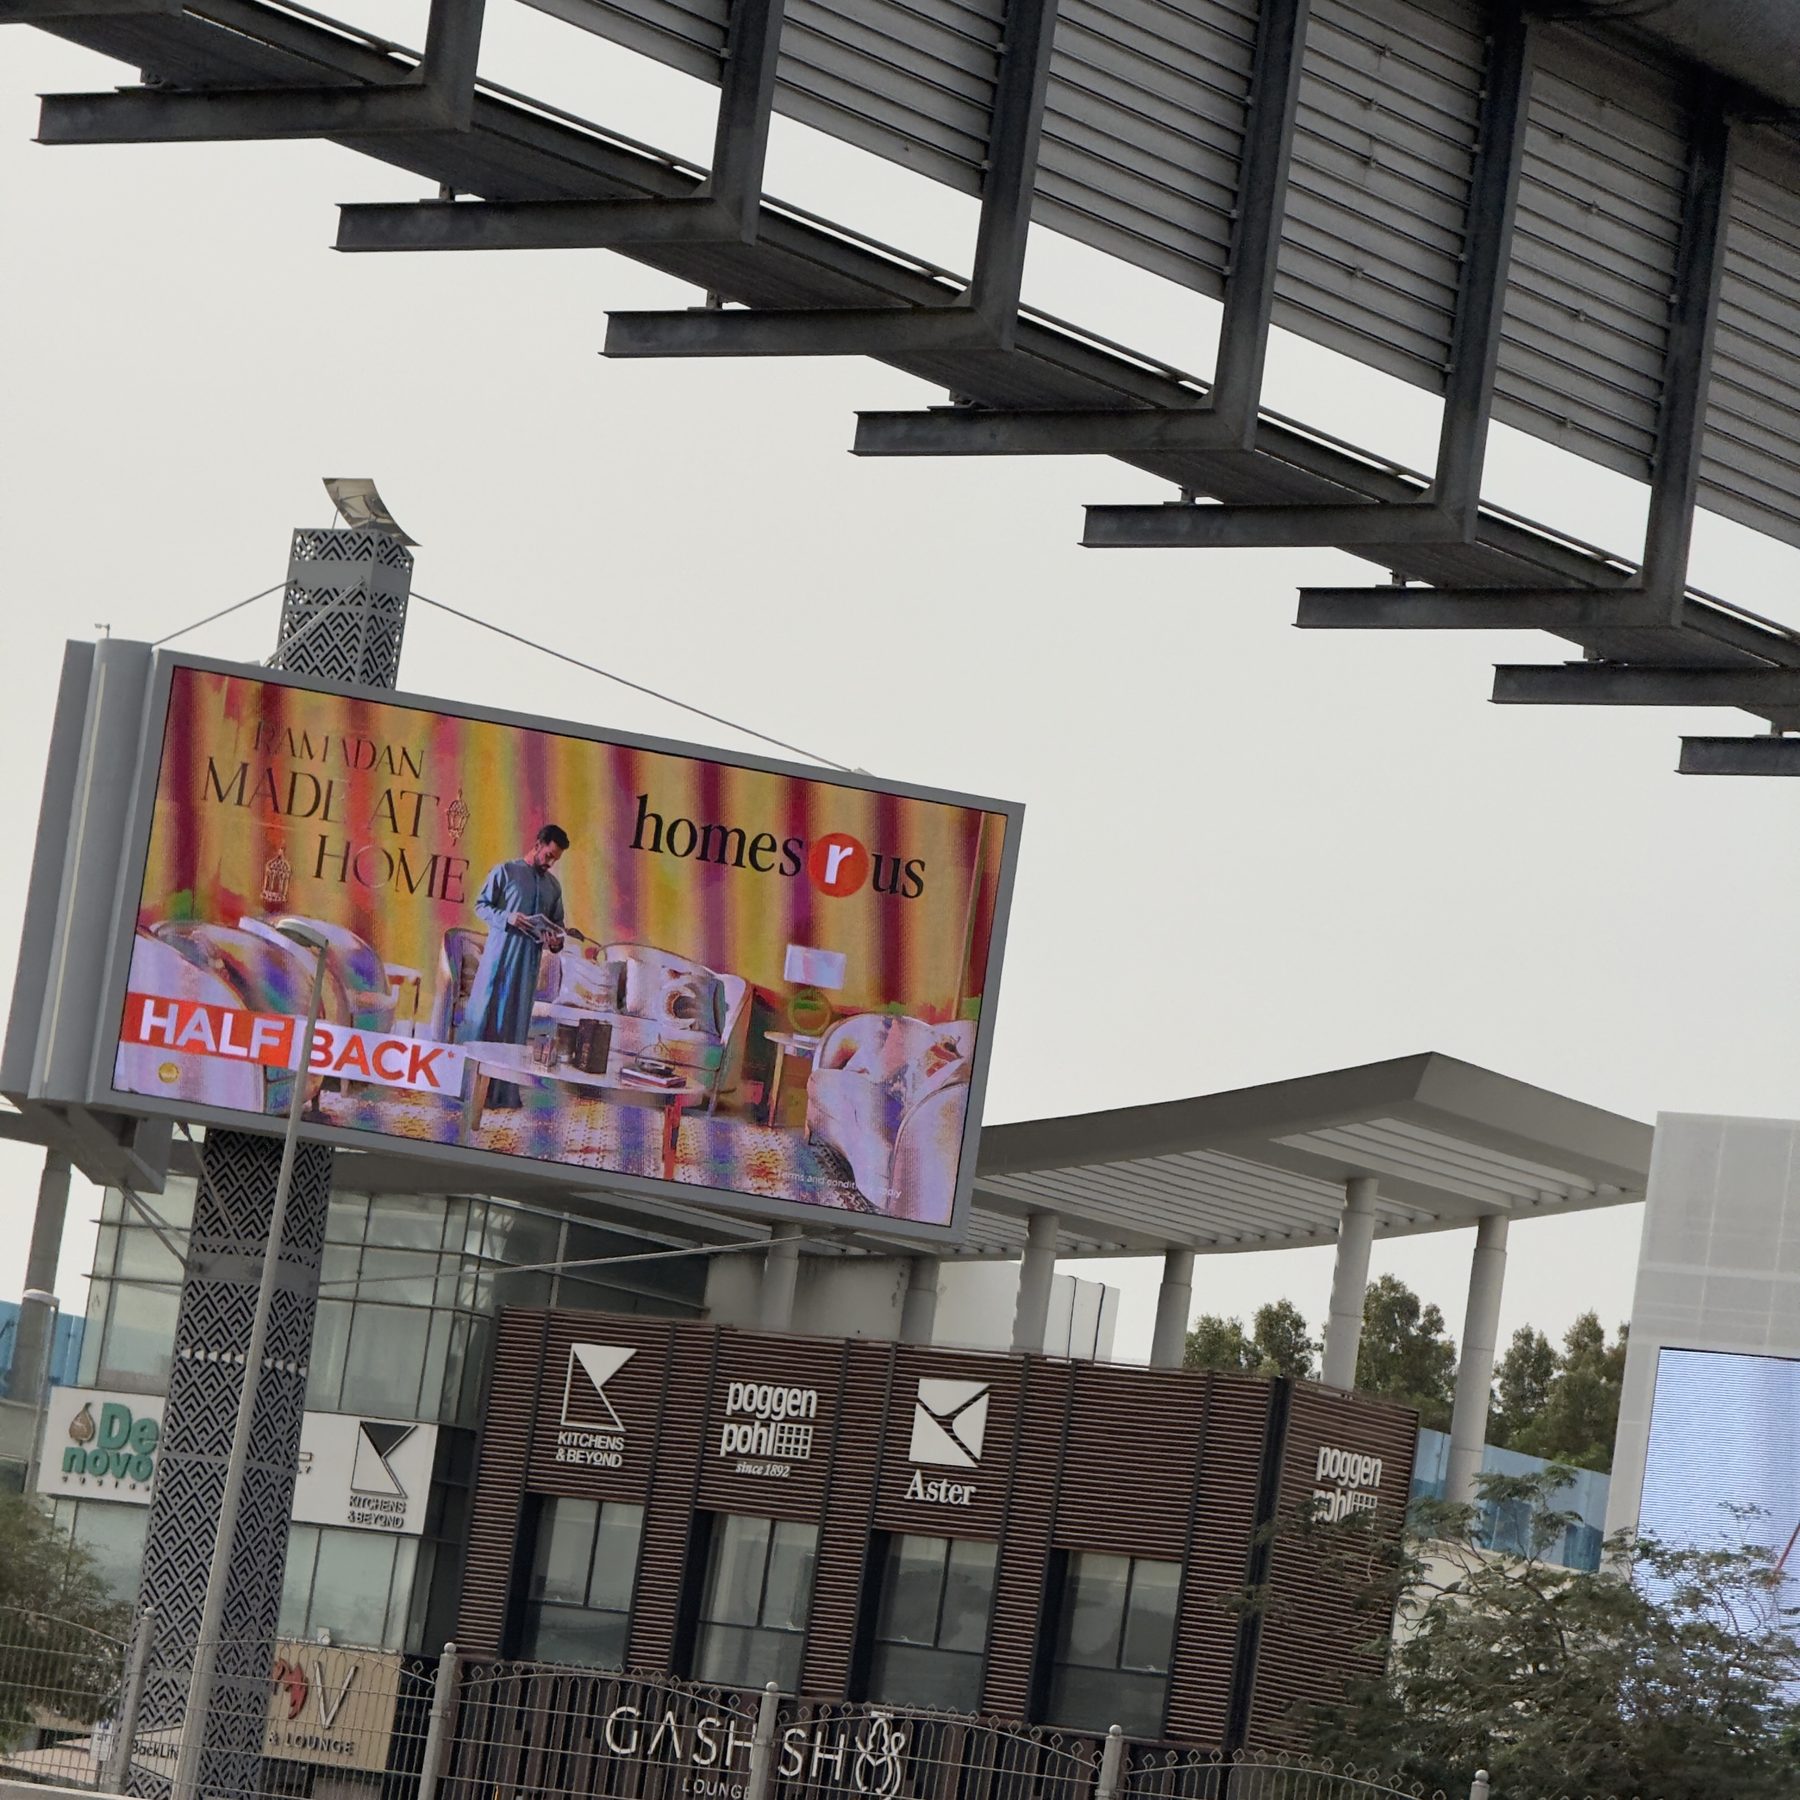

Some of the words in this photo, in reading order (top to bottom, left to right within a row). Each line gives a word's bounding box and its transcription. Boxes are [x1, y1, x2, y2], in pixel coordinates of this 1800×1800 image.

[254, 720, 424, 779] RAMADAN
[367, 788, 440, 838] AT
[629, 794, 804, 877] homes
[824, 843, 852, 884] r
[871, 852, 926, 899] us
[312, 834, 469, 904] HOME
[139, 999, 285, 1058] HALF
[807, 1173, 825, 1185] and
[726, 1382, 818, 1421] poggen
[97, 1402, 159, 1456] De
[557, 1431, 625, 1451] KITCHENS
[720, 1420, 776, 1457] pohl
[62, 1446, 153, 1482] novo
[735, 1462, 763, 1475] since
[763, 1464, 791, 1478] 1892
[1316, 1446, 1382, 1489] poggen
[349, 1495, 407, 1515] KITCHENS
[904, 1469, 977, 1506] Aster
[286, 1732, 355, 1756] LOUNGE
